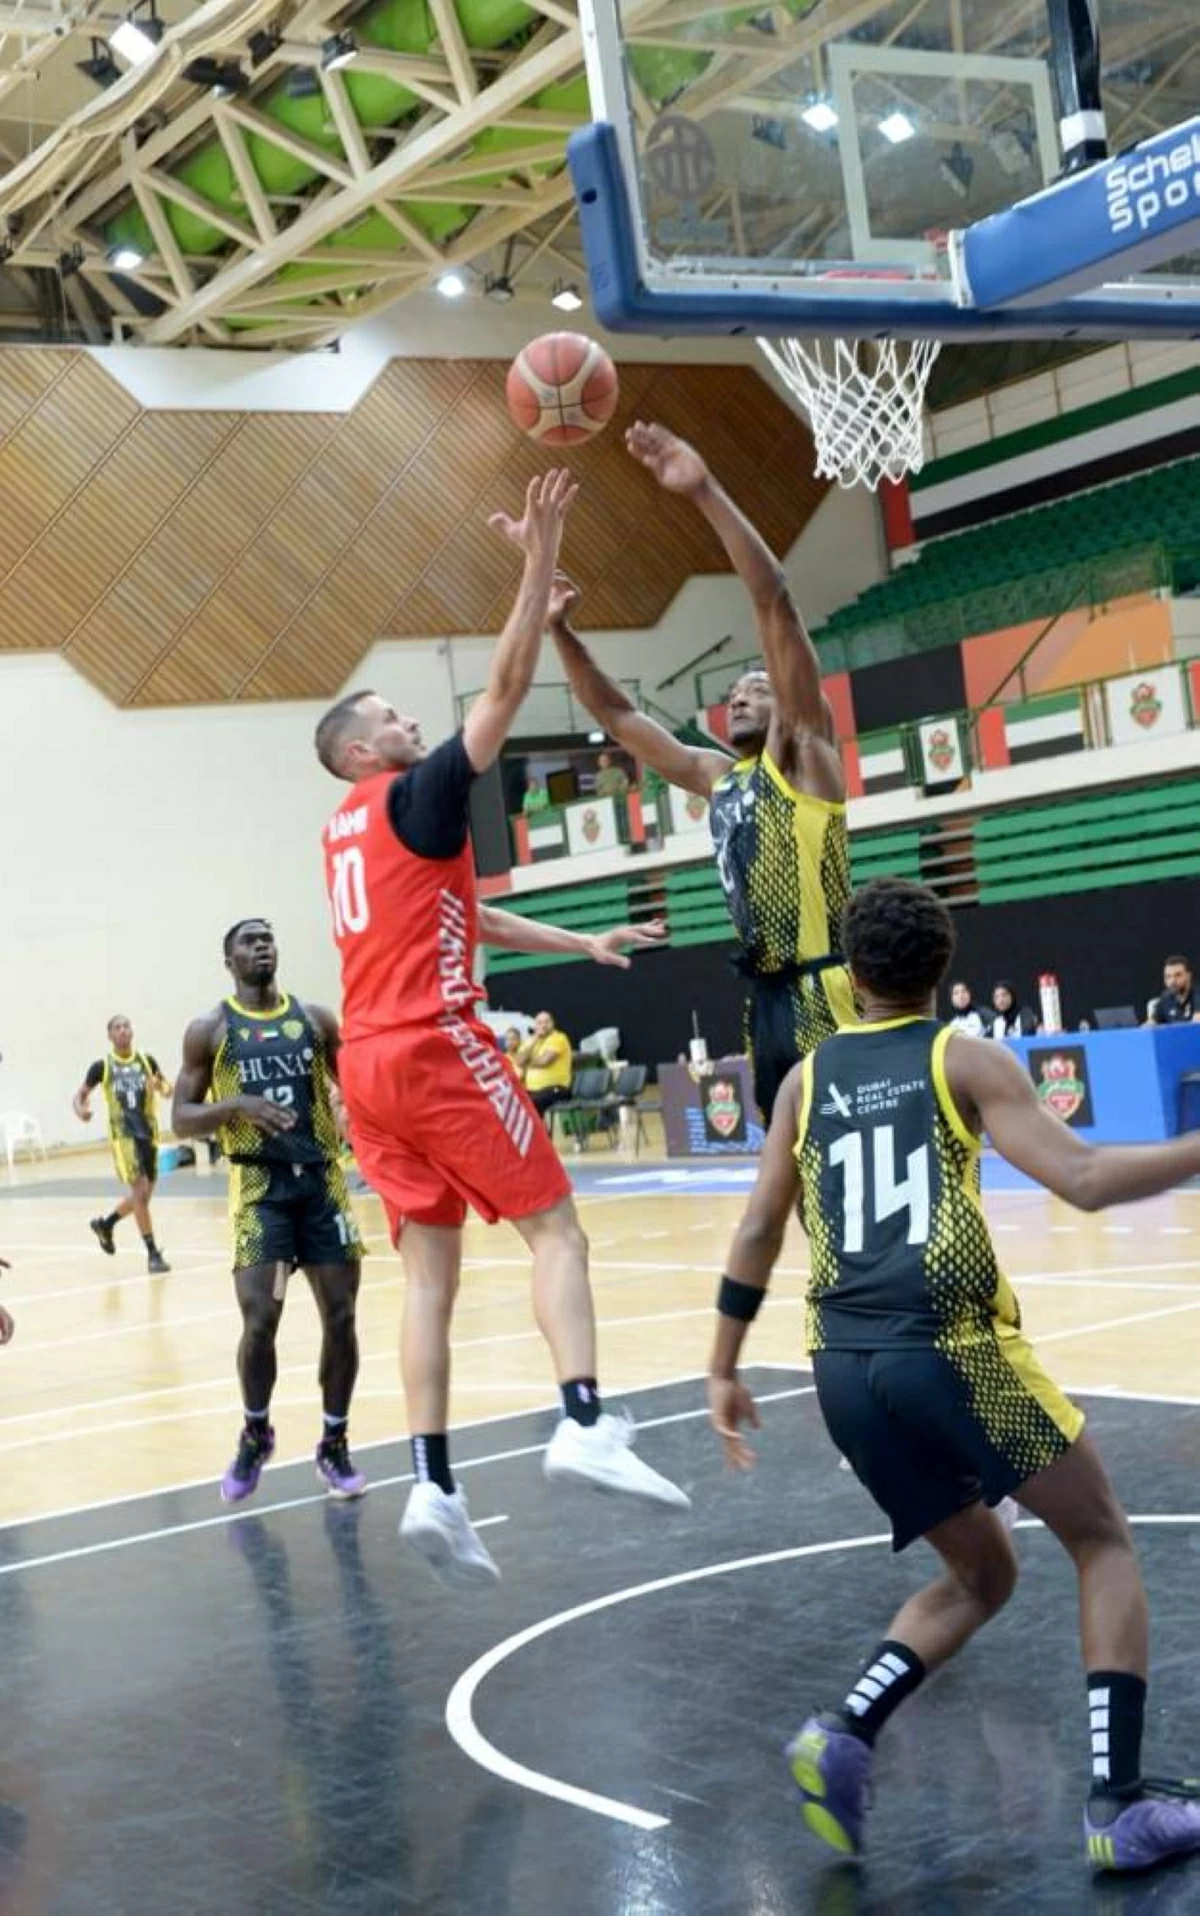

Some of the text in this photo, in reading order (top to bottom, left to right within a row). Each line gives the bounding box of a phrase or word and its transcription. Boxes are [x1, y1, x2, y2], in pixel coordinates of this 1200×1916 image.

[332, 846, 370, 937] 10
[857, 1079, 890, 1093] DUBAI
[857, 1080, 926, 1104] REAL ESTATE
[857, 1098, 899, 1115] CENTRE
[829, 1125, 929, 1252] 14
